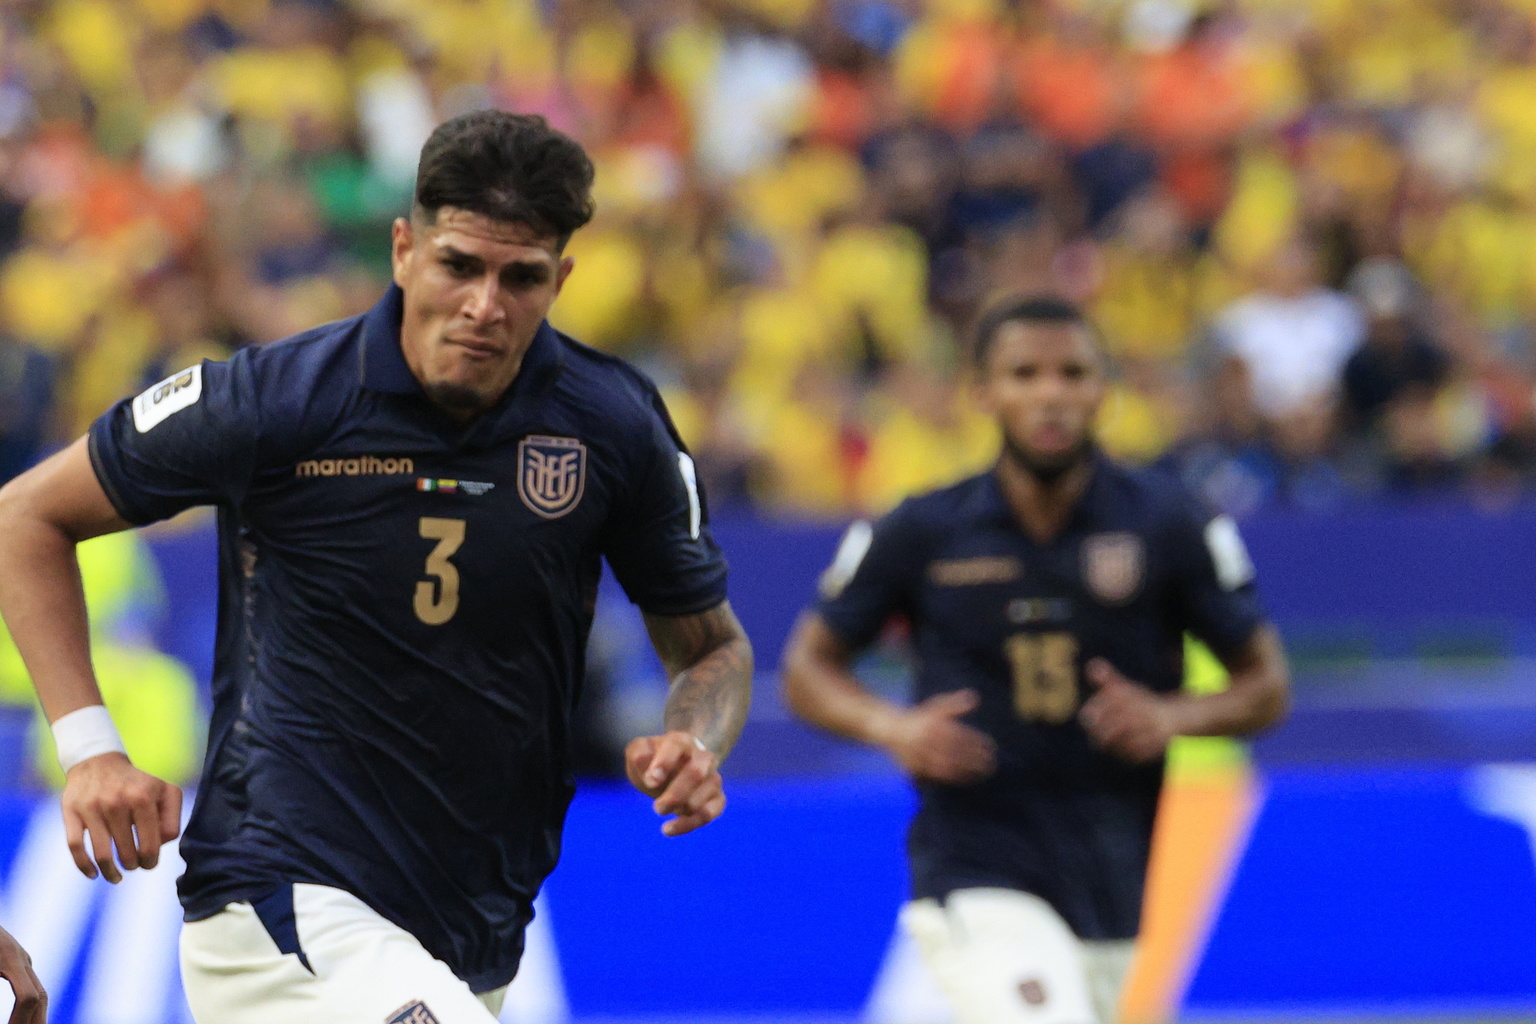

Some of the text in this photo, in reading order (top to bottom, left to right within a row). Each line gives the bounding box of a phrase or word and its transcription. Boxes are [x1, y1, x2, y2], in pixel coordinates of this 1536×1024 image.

[296, 456, 413, 477] marathon
[413, 517, 466, 625] 3
[1005, 632, 1078, 722] 15
